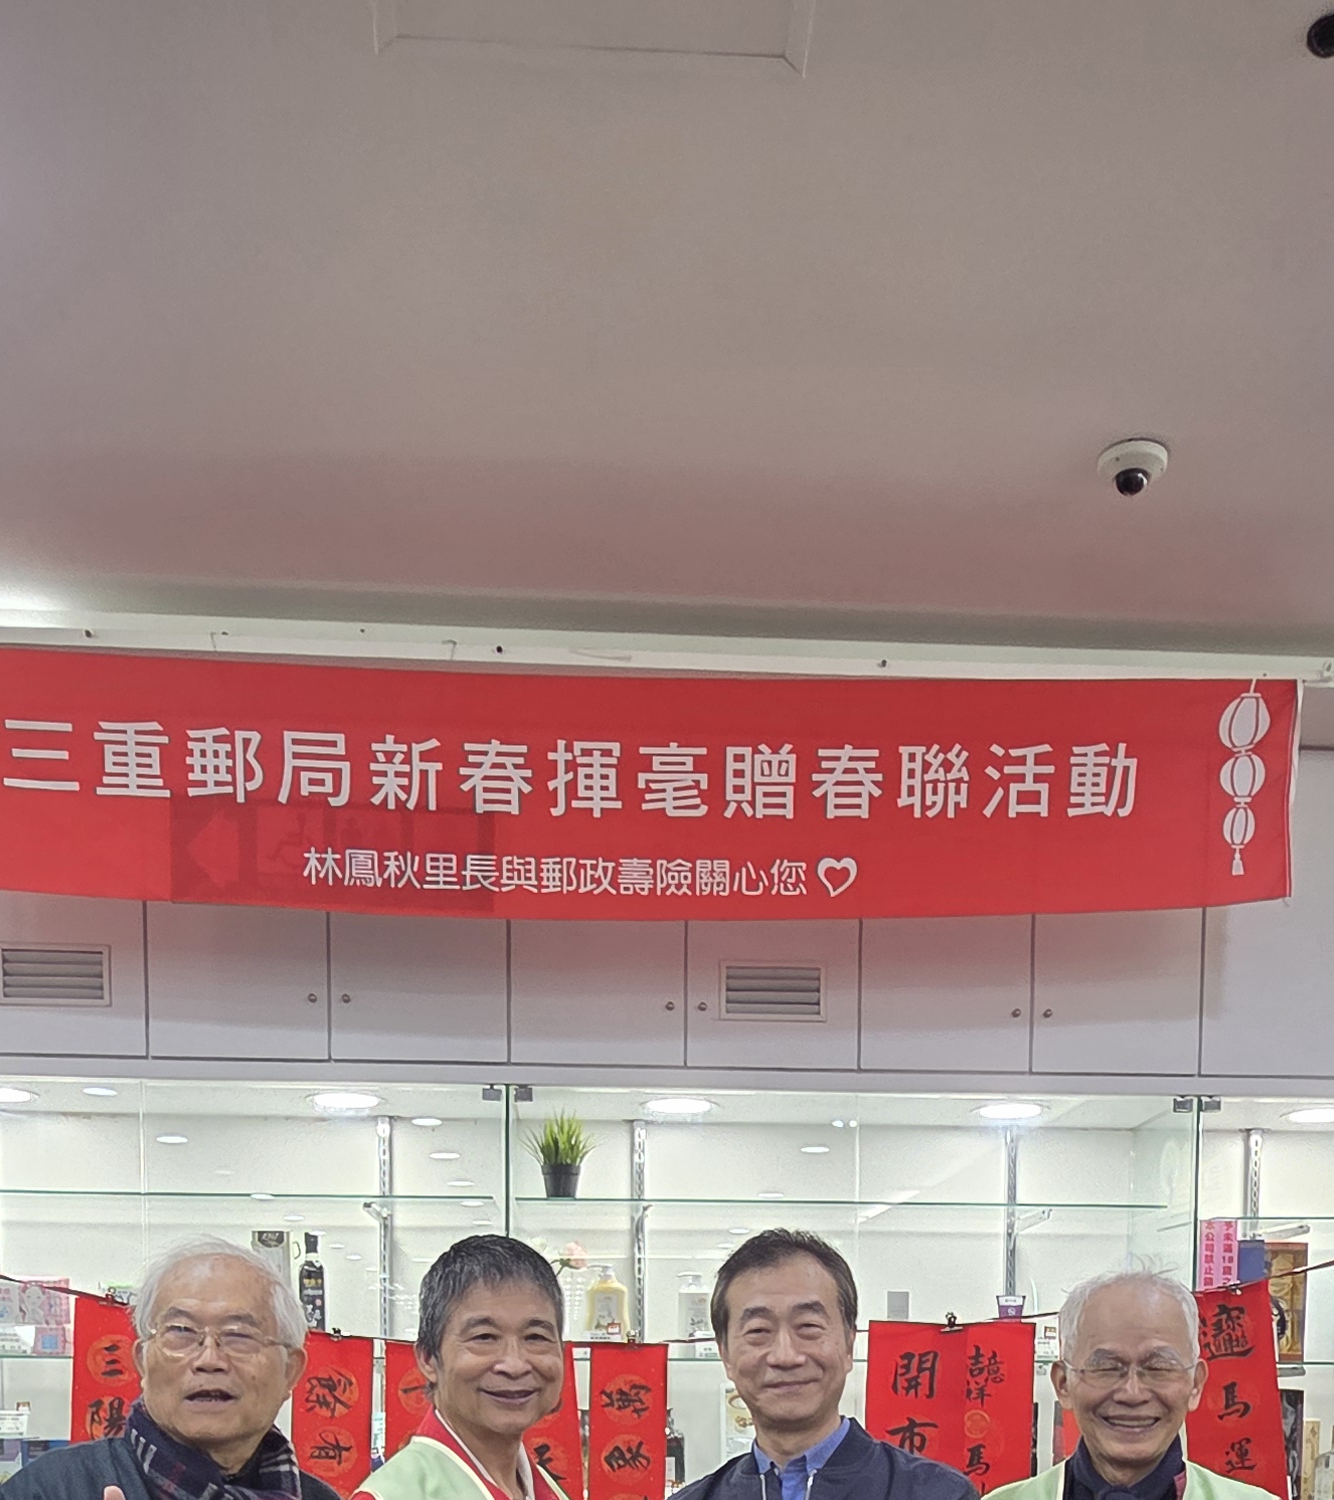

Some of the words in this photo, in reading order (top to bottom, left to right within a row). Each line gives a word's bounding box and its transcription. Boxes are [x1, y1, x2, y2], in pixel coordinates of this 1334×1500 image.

[3, 718, 1138, 819] 三重郵局新春揮毫贈春聯活動
[302, 846, 807, 896] 林鳳秋里長與郵政壽險關心您
